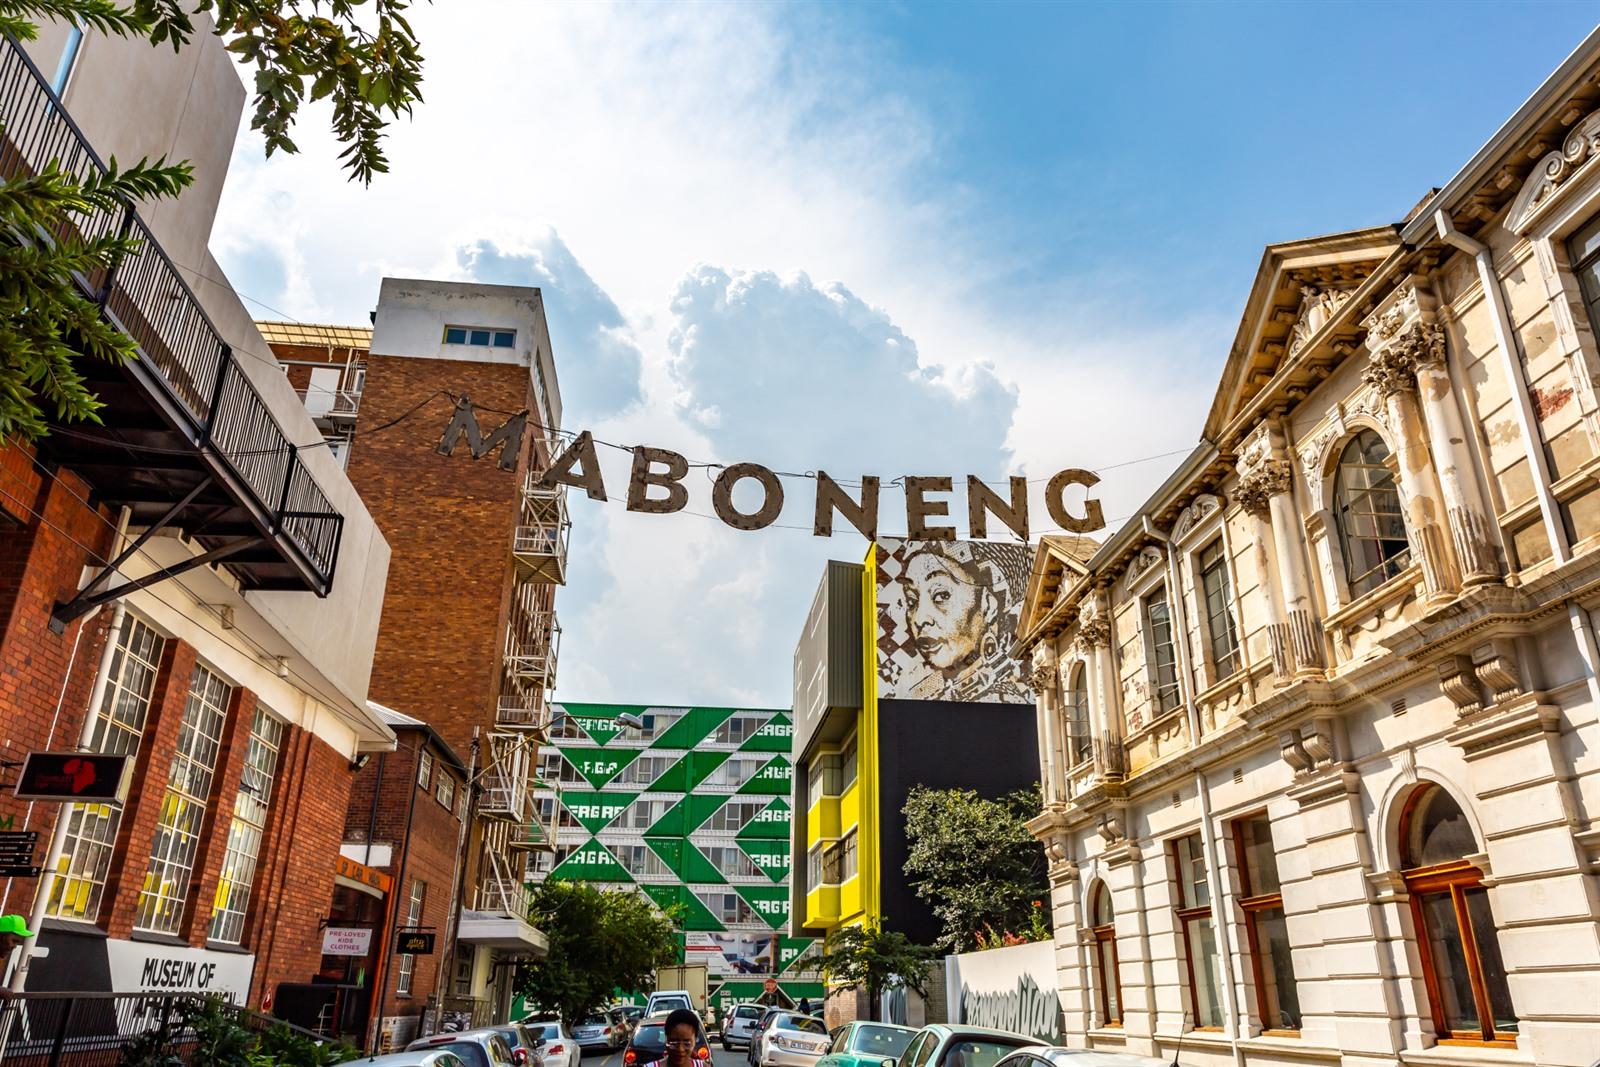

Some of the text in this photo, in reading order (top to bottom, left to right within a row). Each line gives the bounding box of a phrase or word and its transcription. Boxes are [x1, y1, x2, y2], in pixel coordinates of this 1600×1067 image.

[435, 393, 1106, 541] MABONENG
[329, 930, 366, 938] PRE-LOVED
[140, 957, 217, 989] MUSEUM OF
